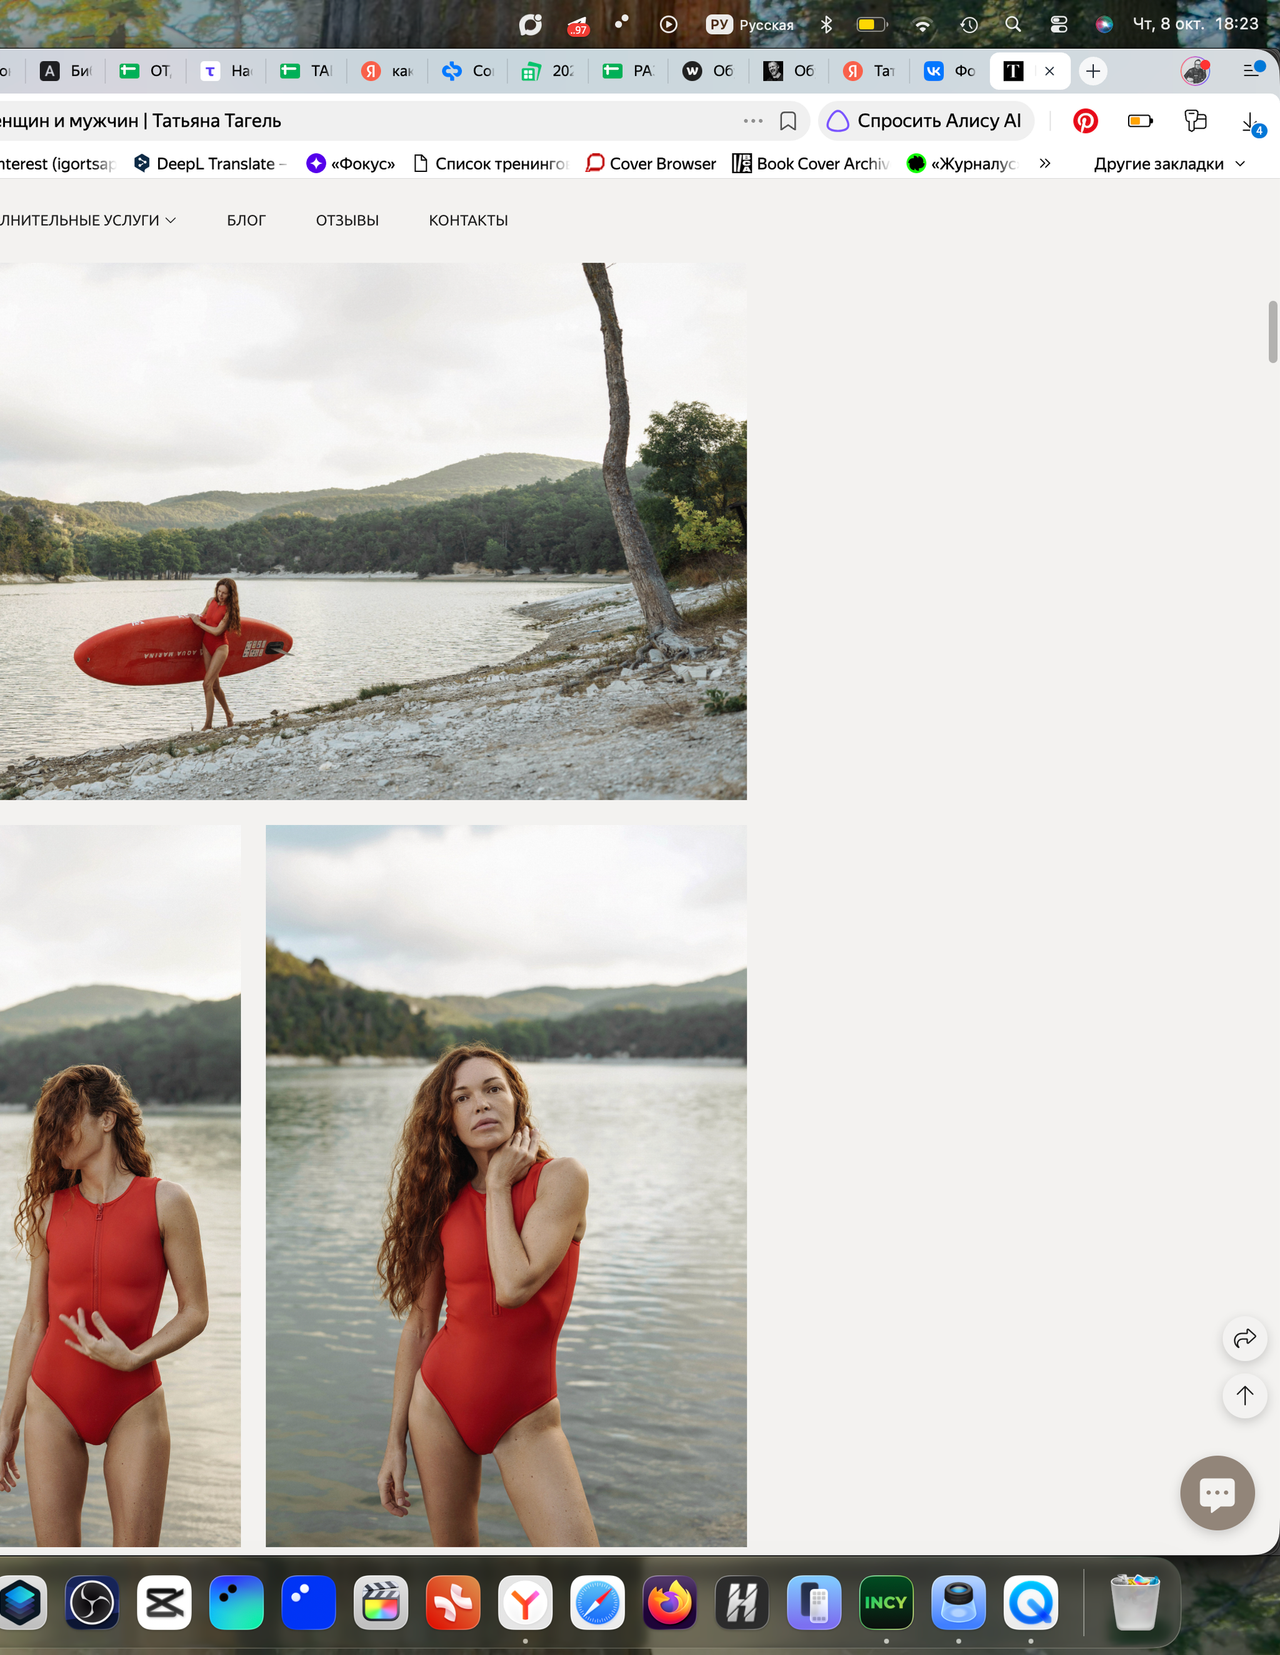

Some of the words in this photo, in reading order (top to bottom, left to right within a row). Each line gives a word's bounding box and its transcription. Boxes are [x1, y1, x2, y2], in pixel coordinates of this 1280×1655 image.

[740, 19, 794, 33] Русская
[1133, 17, 1156, 33] Чт,
[1160, 17, 1171, 30] 8
[1175, 19, 1205, 30] окт.
[1215, 17, 1259, 30] 18:23
[71, 64, 93, 77] Би
[150, 64, 172, 79] ОТ
[310, 64, 333, 77] ТА
[634, 64, 655, 77] РА
[954, 64, 976, 78] Фо
[54, 116, 65, 128] и
[69, 116, 139, 132] мужчин
[151, 112, 221, 129] Татьяна
[223, 112, 282, 129] Тагель
[857, 112, 942, 132] Спросить
[945, 112, 1001, 132] Алису
[1003, 112, 1021, 128] AI
[1255, 126, 1263, 136] 4
[157, 156, 205, 174] DeepL
[207, 156, 276, 171] Translate
[331, 156, 396, 174] «Фокус»
[435, 156, 492, 171] Список
[609, 156, 654, 171] Cover
[656, 156, 717, 171] Browser
[757, 156, 795, 171] Book
[797, 156, 841, 171] Cover
[843, 156, 891, 171] Archiv
[1093, 156, 1151, 174] Другие
[1154, 156, 1225, 173] закладки
[103, 214, 160, 227] УСЛУГИ
[227, 214, 267, 227] БЛОГ
[315, 214, 379, 227] ОТЗЫВЫ
[429, 214, 508, 227] КОНТАКТЫ
[143, 650, 174, 659] MARINA
[177, 649, 197, 657] AQUA
[864, 1595, 908, 1610] INCY
